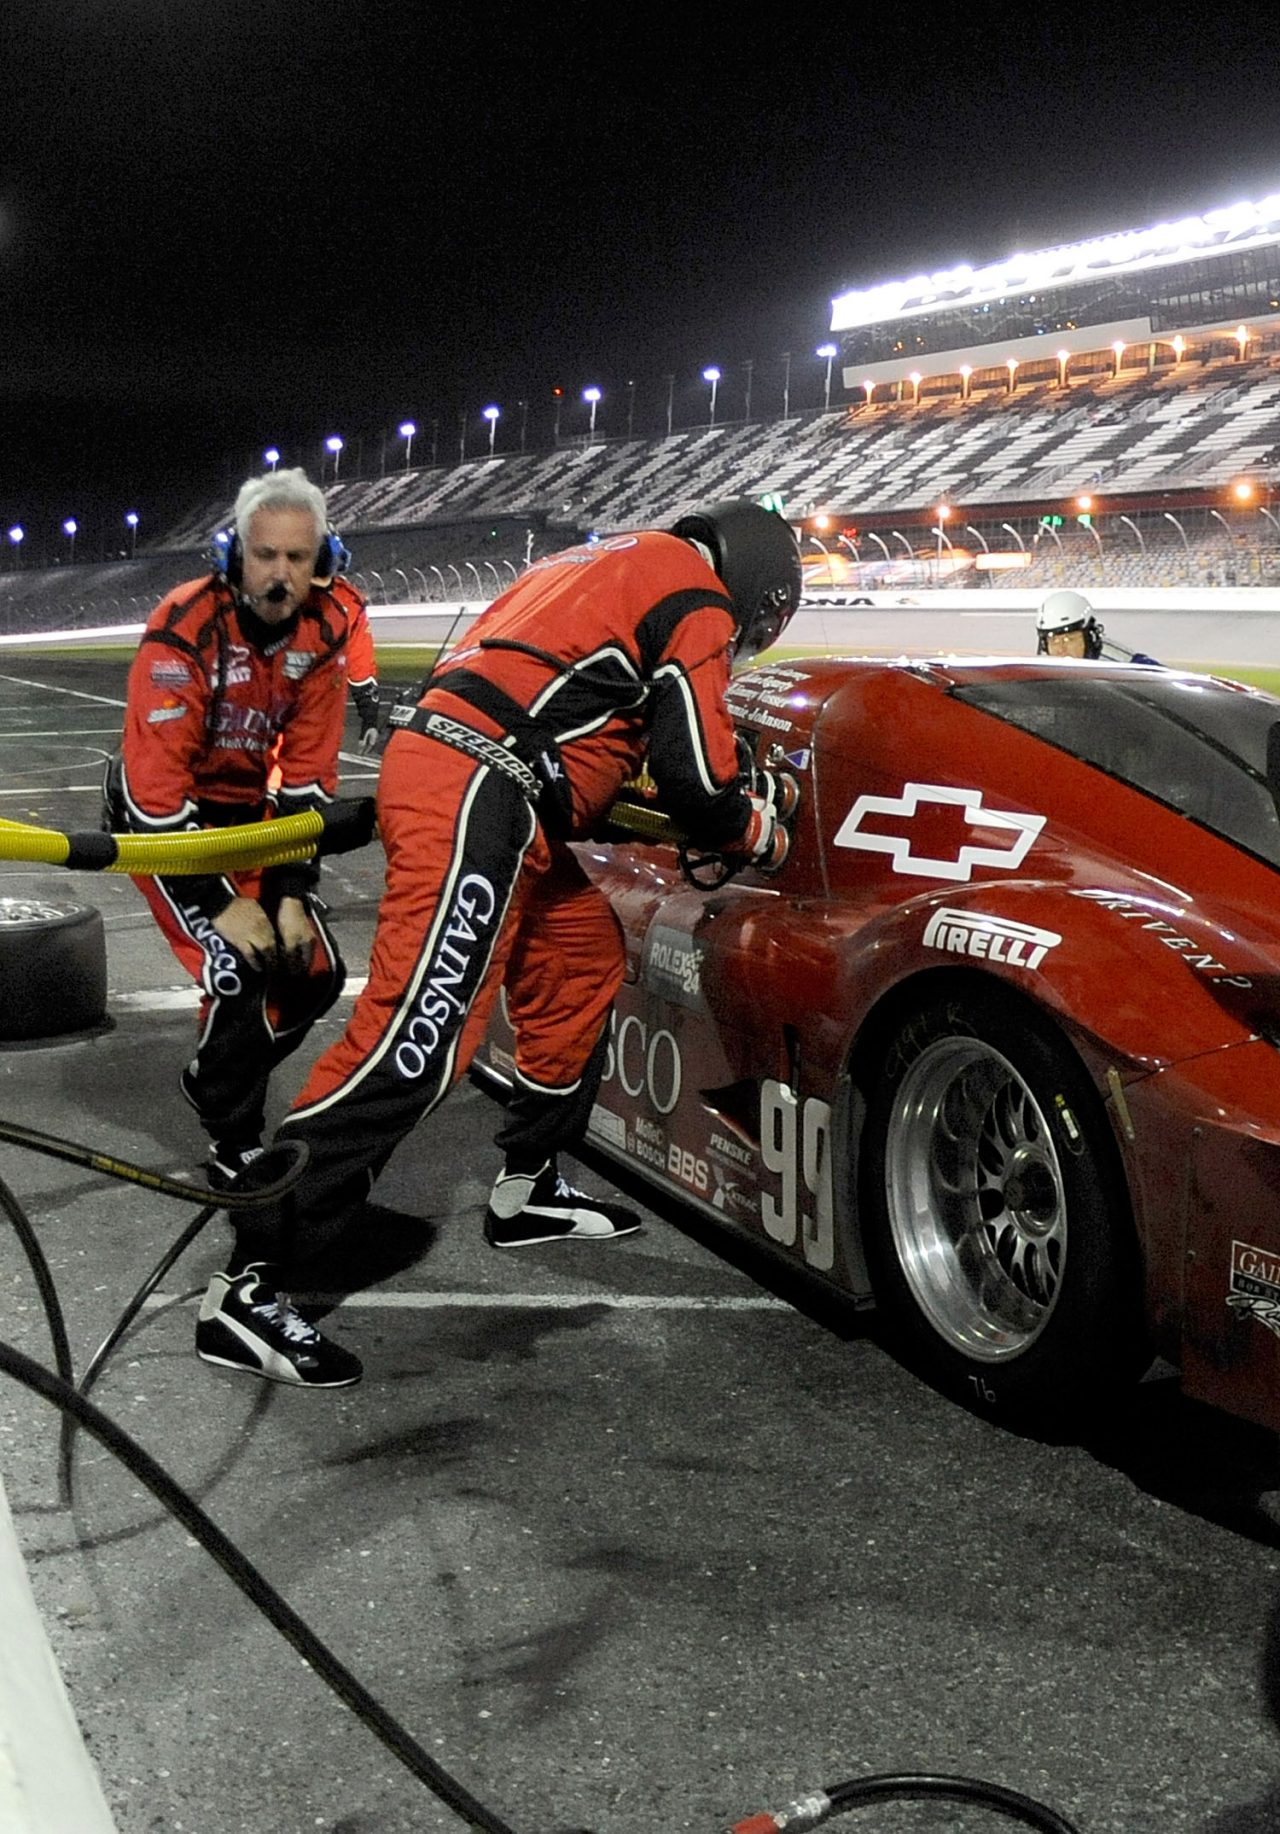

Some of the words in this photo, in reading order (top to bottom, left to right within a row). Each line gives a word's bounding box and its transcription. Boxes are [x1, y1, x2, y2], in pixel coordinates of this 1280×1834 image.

[748, 707, 793, 733] Johnson
[922, 907, 1063, 970] PIRELLI
[396, 873, 496, 1079] GAINSCO
[650, 942, 690, 976] ROLEX
[682, 968, 700, 995] 24
[636, 1139, 666, 1170] BOSCH
[667, 1143, 709, 1191] BBS
[710, 1133, 752, 1166] PENSKE
[760, 1079, 834, 1272] 99
